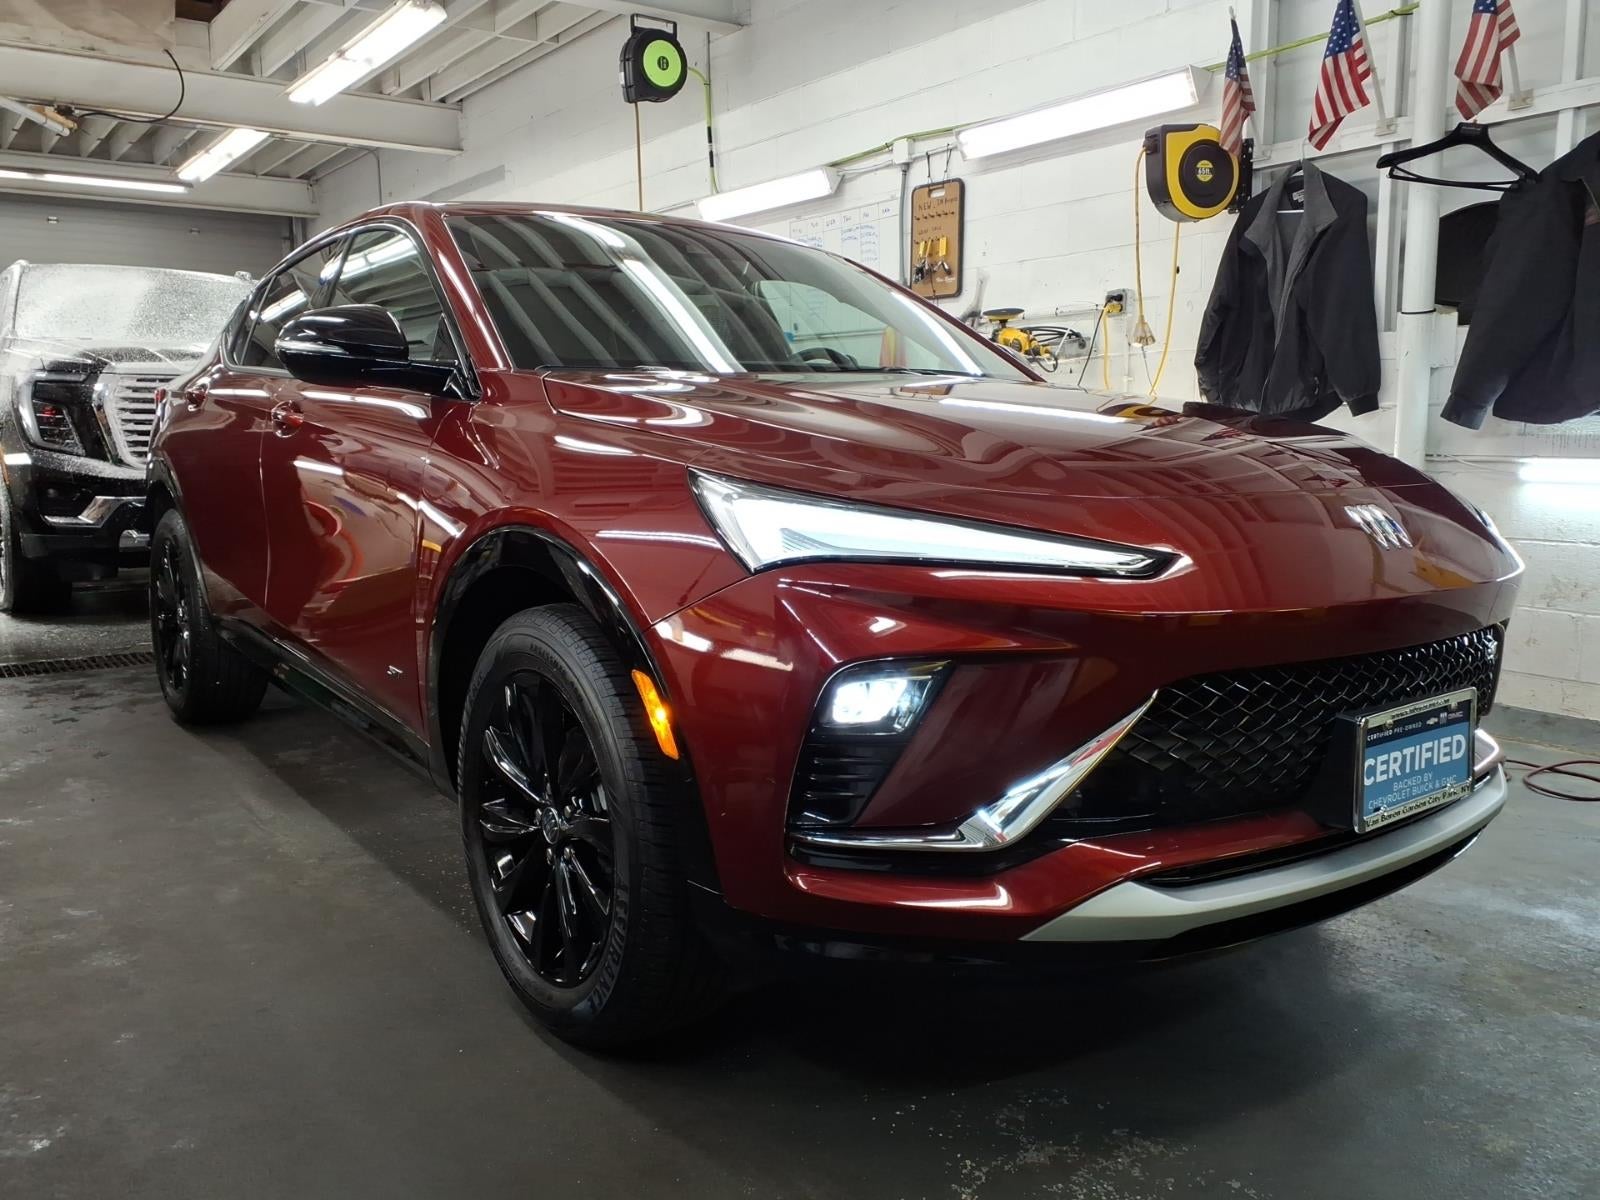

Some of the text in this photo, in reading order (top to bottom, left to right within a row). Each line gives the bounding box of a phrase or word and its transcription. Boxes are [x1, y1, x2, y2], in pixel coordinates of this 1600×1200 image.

[1363, 734, 1466, 786] CERTIFIED
[1368, 787, 1410, 810] CHEVROLET
[1412, 782, 1434, 795] BUICK
[1441, 774, 1457, 786] GMC
[1393, 772, 1433, 792] BACKED BY
[1366, 817, 1379, 828] Van
[1427, 793, 1441, 806] City
[1460, 784, 1471, 794] NY
